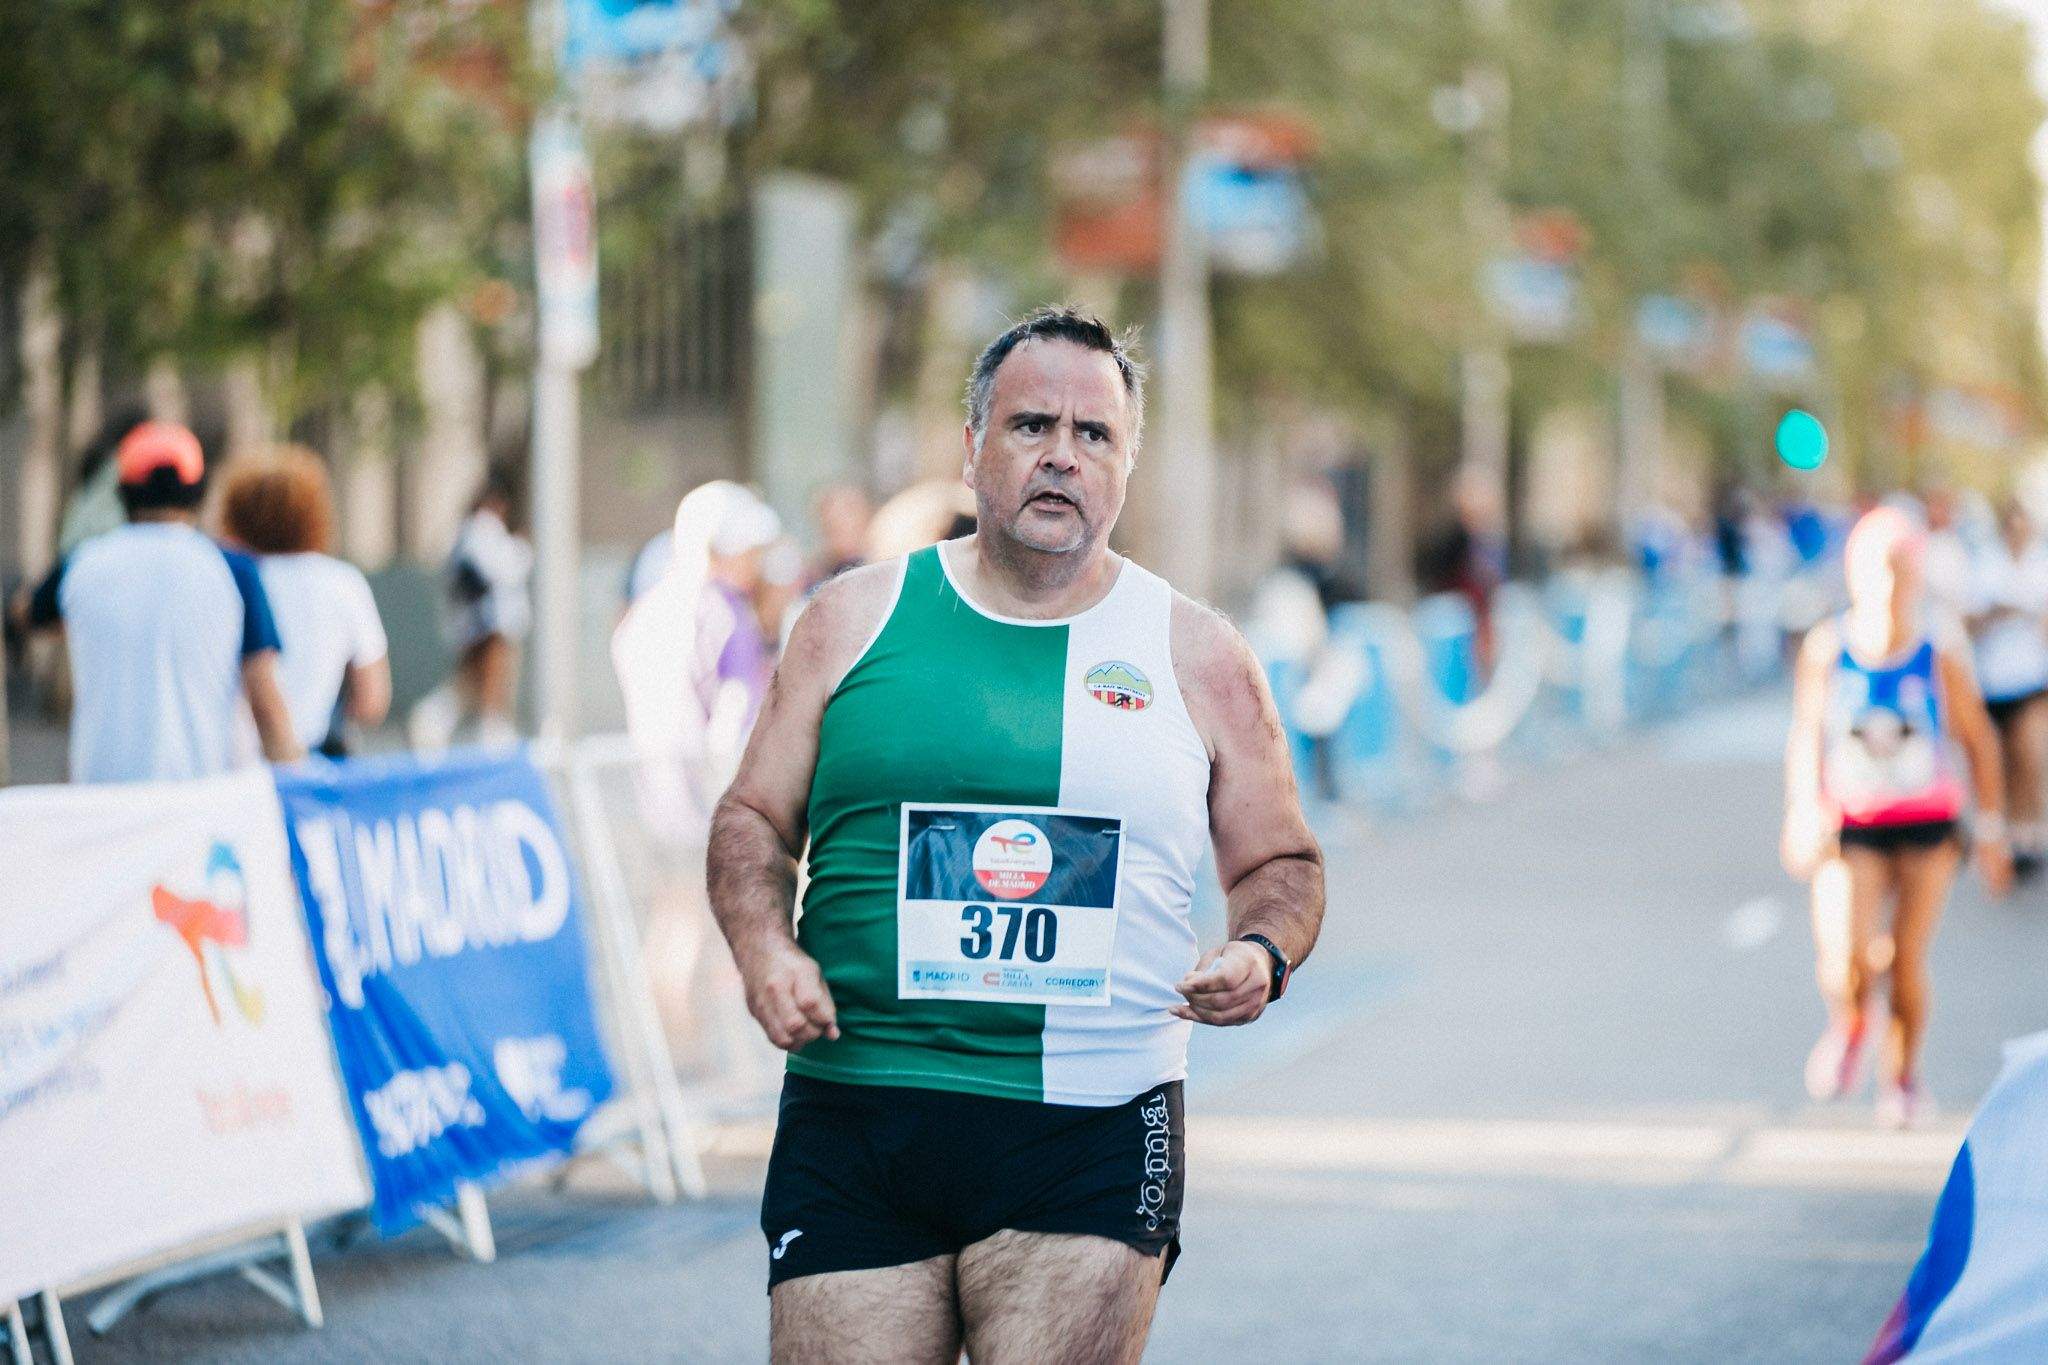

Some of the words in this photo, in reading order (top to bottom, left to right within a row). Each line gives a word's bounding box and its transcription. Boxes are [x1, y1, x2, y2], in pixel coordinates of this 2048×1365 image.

[999, 871, 1026, 881] MILLA
[988, 879, 999, 888] DE
[1001, 880, 1036, 889] MADRID
[960, 904, 1058, 963] 370
[925, 971, 970, 982] MADRID
